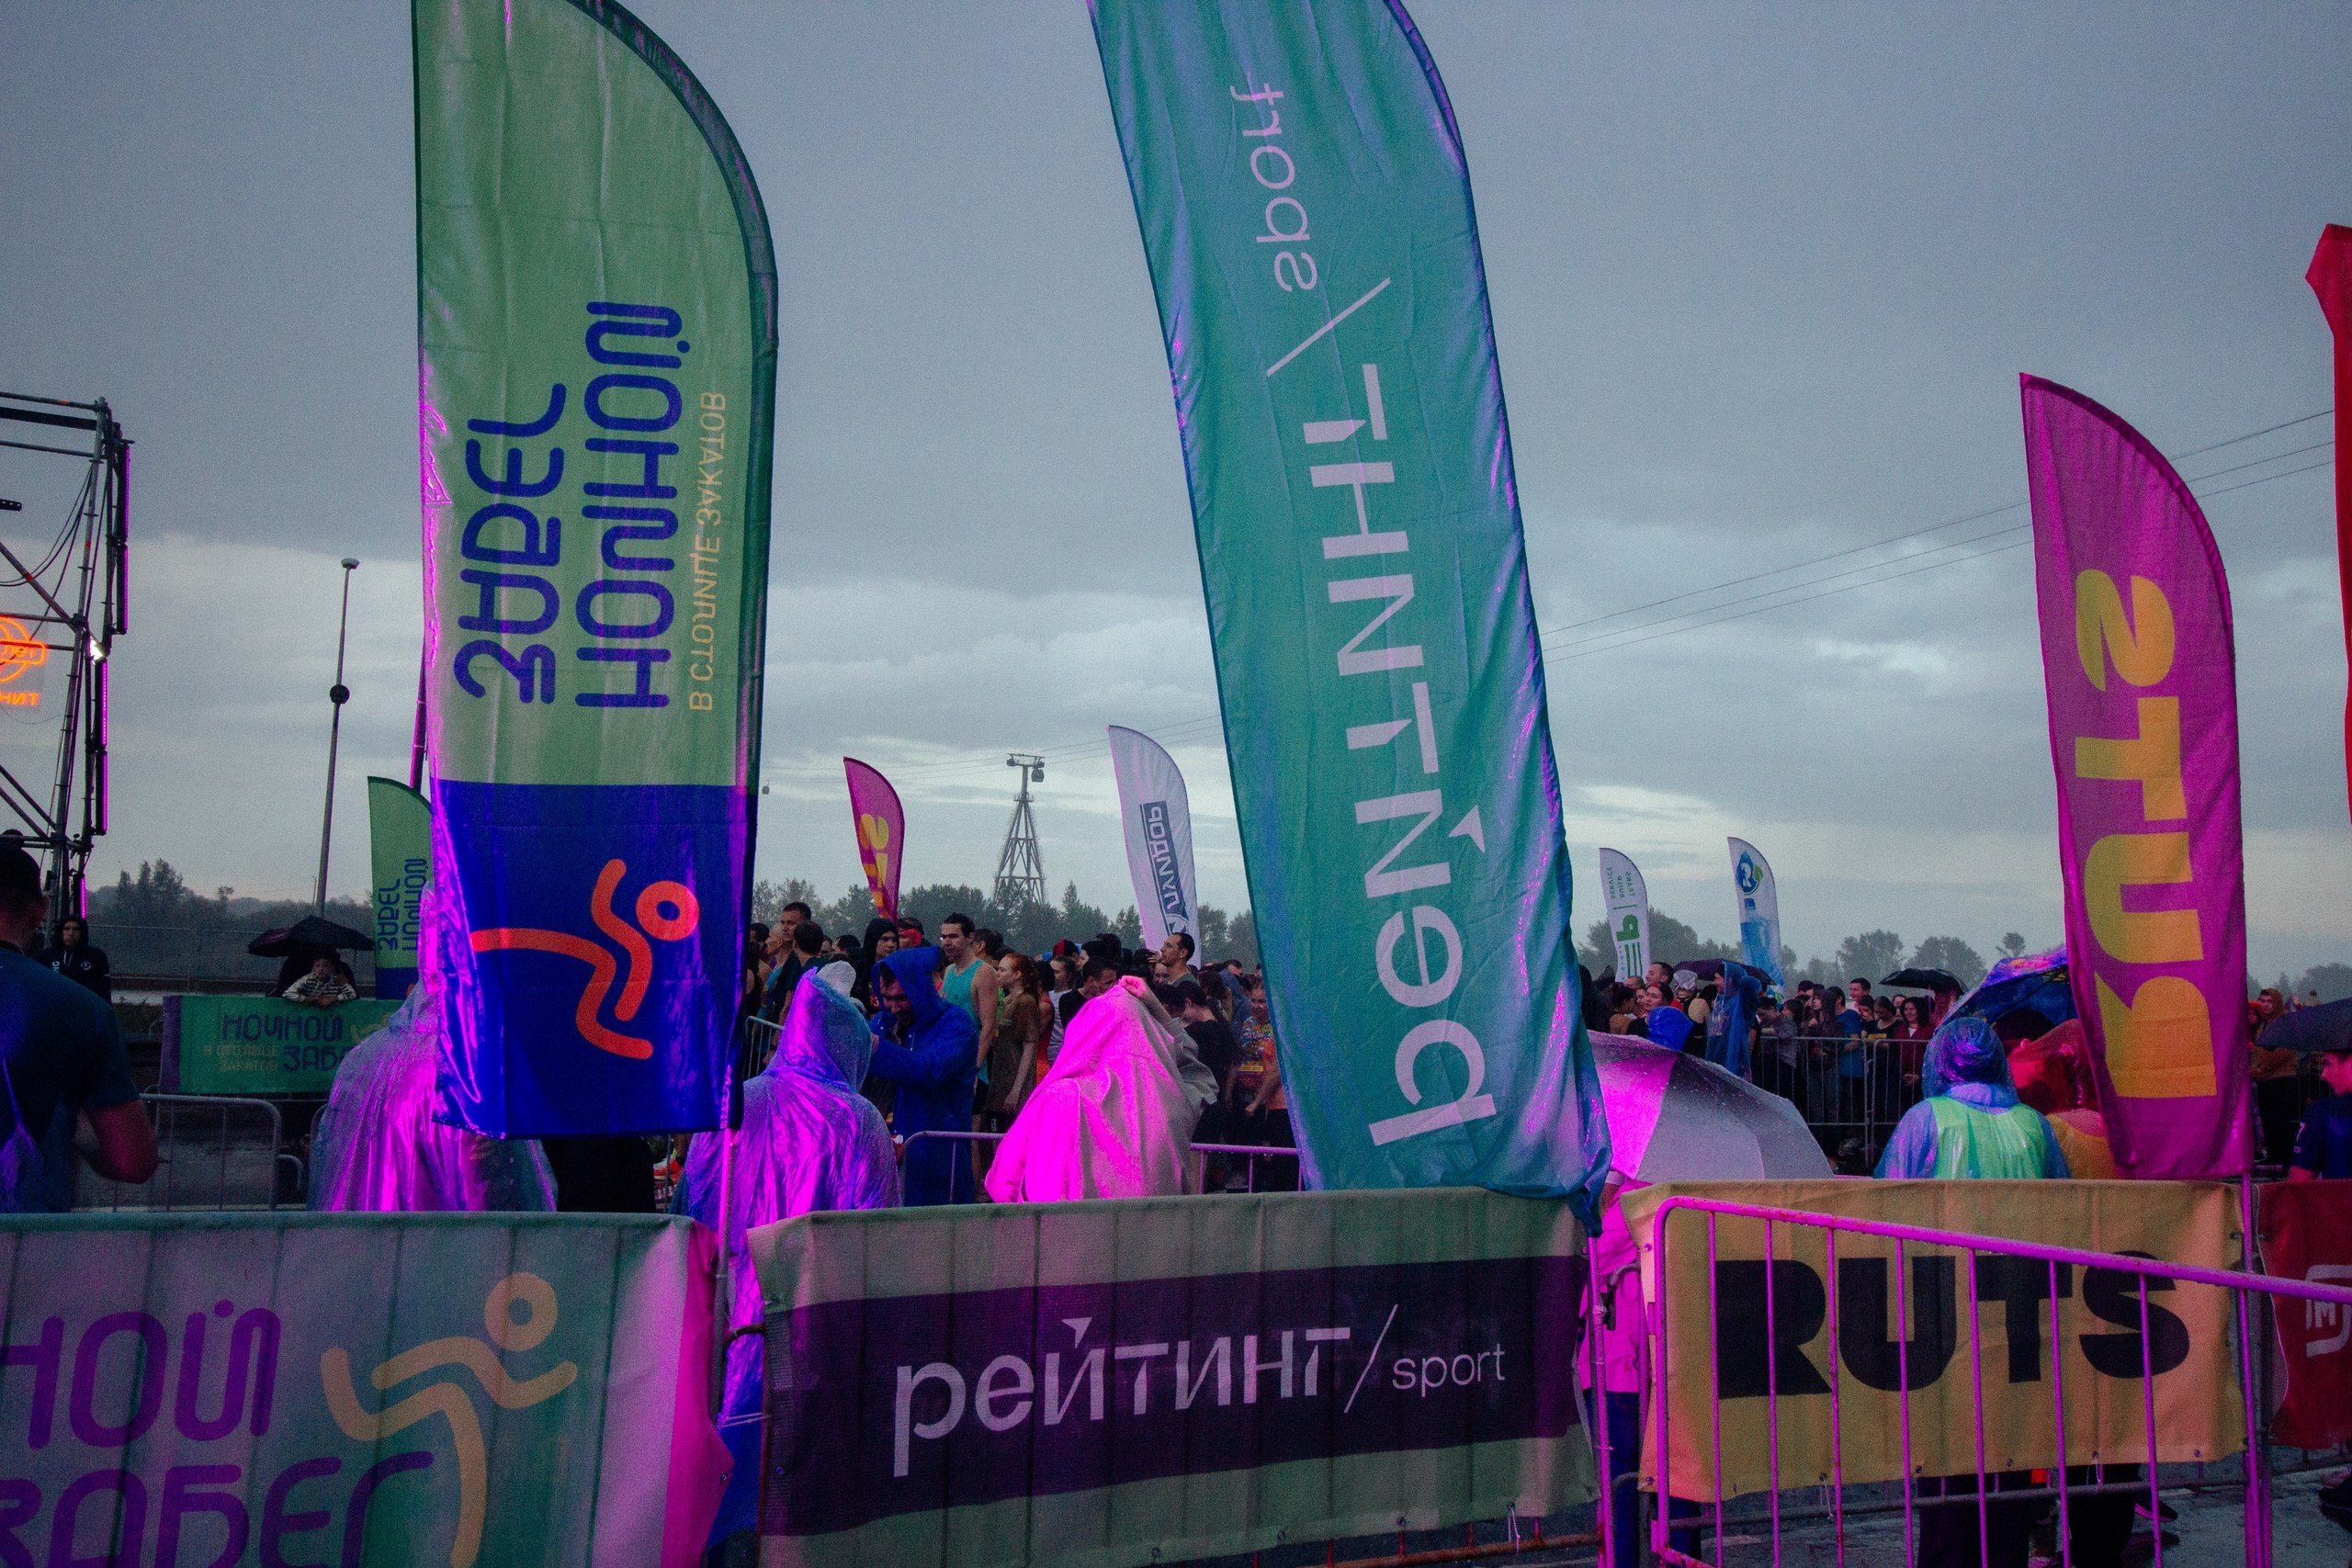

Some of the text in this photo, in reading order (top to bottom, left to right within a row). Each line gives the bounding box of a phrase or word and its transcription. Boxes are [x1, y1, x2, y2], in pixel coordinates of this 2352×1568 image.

[221, 1013, 344, 1042] НОЧНОЙ
[282, 1044, 350, 1072] ЗАБ
[1714, 1250, 2190, 1400] RUTS
[1390, 1342, 1507, 1397] sport
